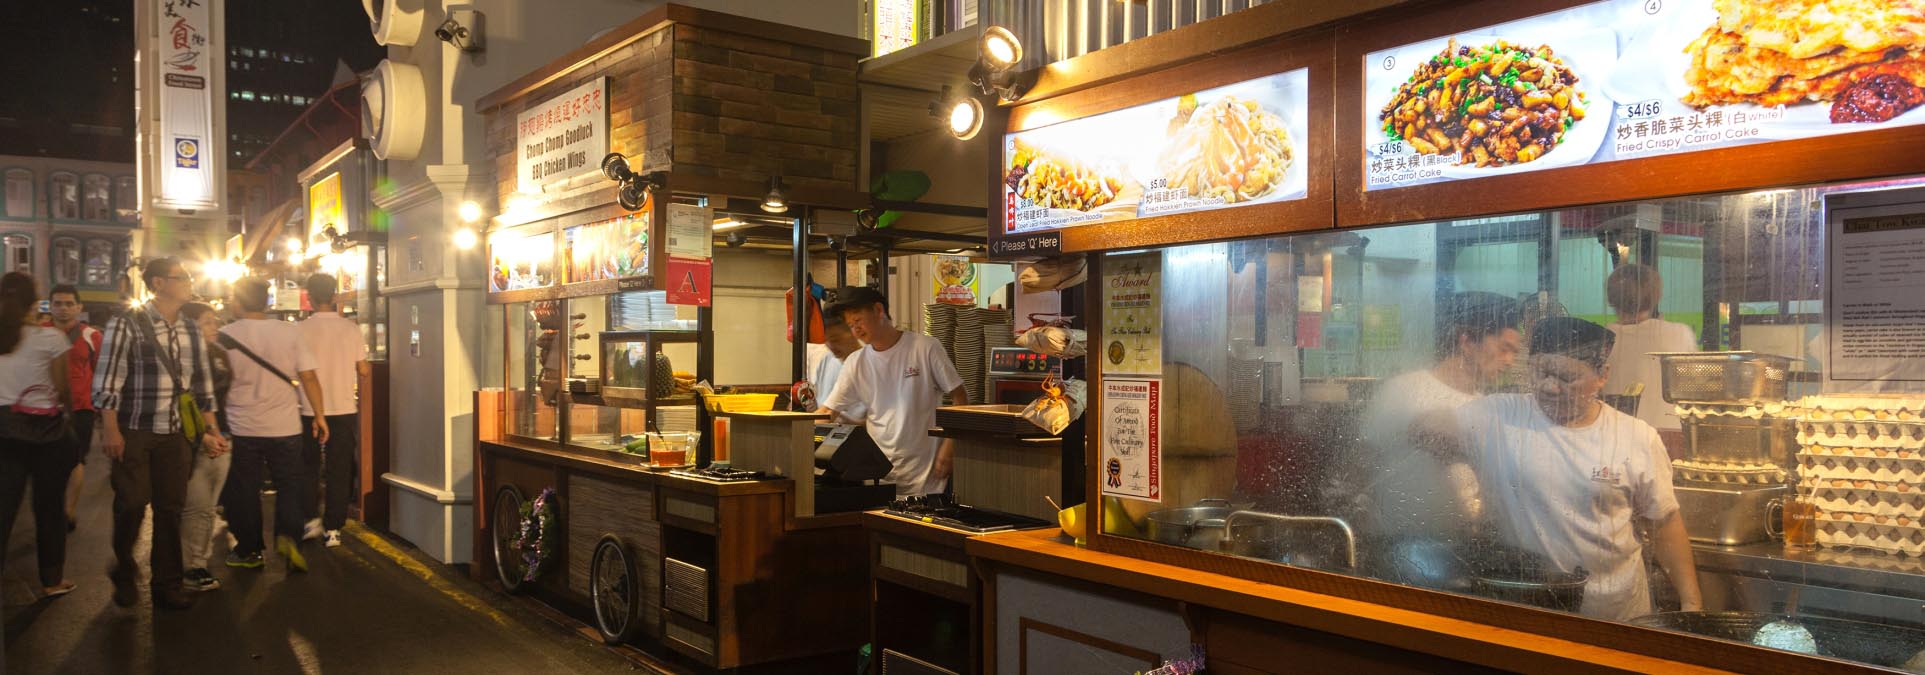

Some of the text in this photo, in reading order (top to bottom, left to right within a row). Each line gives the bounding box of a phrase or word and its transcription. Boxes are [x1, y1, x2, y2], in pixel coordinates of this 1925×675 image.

[1627, 101, 1660, 118] $4/$6
[1616, 111, 1724, 140] 炒香脆菜头粿
[526, 121, 593, 160] Chomp Chomp Goodluck
[1379, 142, 1402, 155] $4/$6
[1616, 127, 1759, 153] Fried Crispy Carrot Cake
[544, 157, 566, 177] Chicken
[567, 151, 586, 170] Wings
[1371, 154, 1421, 174] 炒菜头粿
[1150, 178, 1167, 190] $5.00
[1371, 168, 1442, 185] Fried Carrot Cake
[1145, 205, 1159, 213] Fried
[1159, 203, 1183, 211] Hokkien
[1202, 197, 1225, 206] Noodle
[1001, 240, 1026, 253] Please
[1038, 237, 1058, 249] Here
[677, 271, 701, 294] A
[1111, 271, 1153, 289] Award
[1149, 386, 1158, 484] Singapore Food Map
